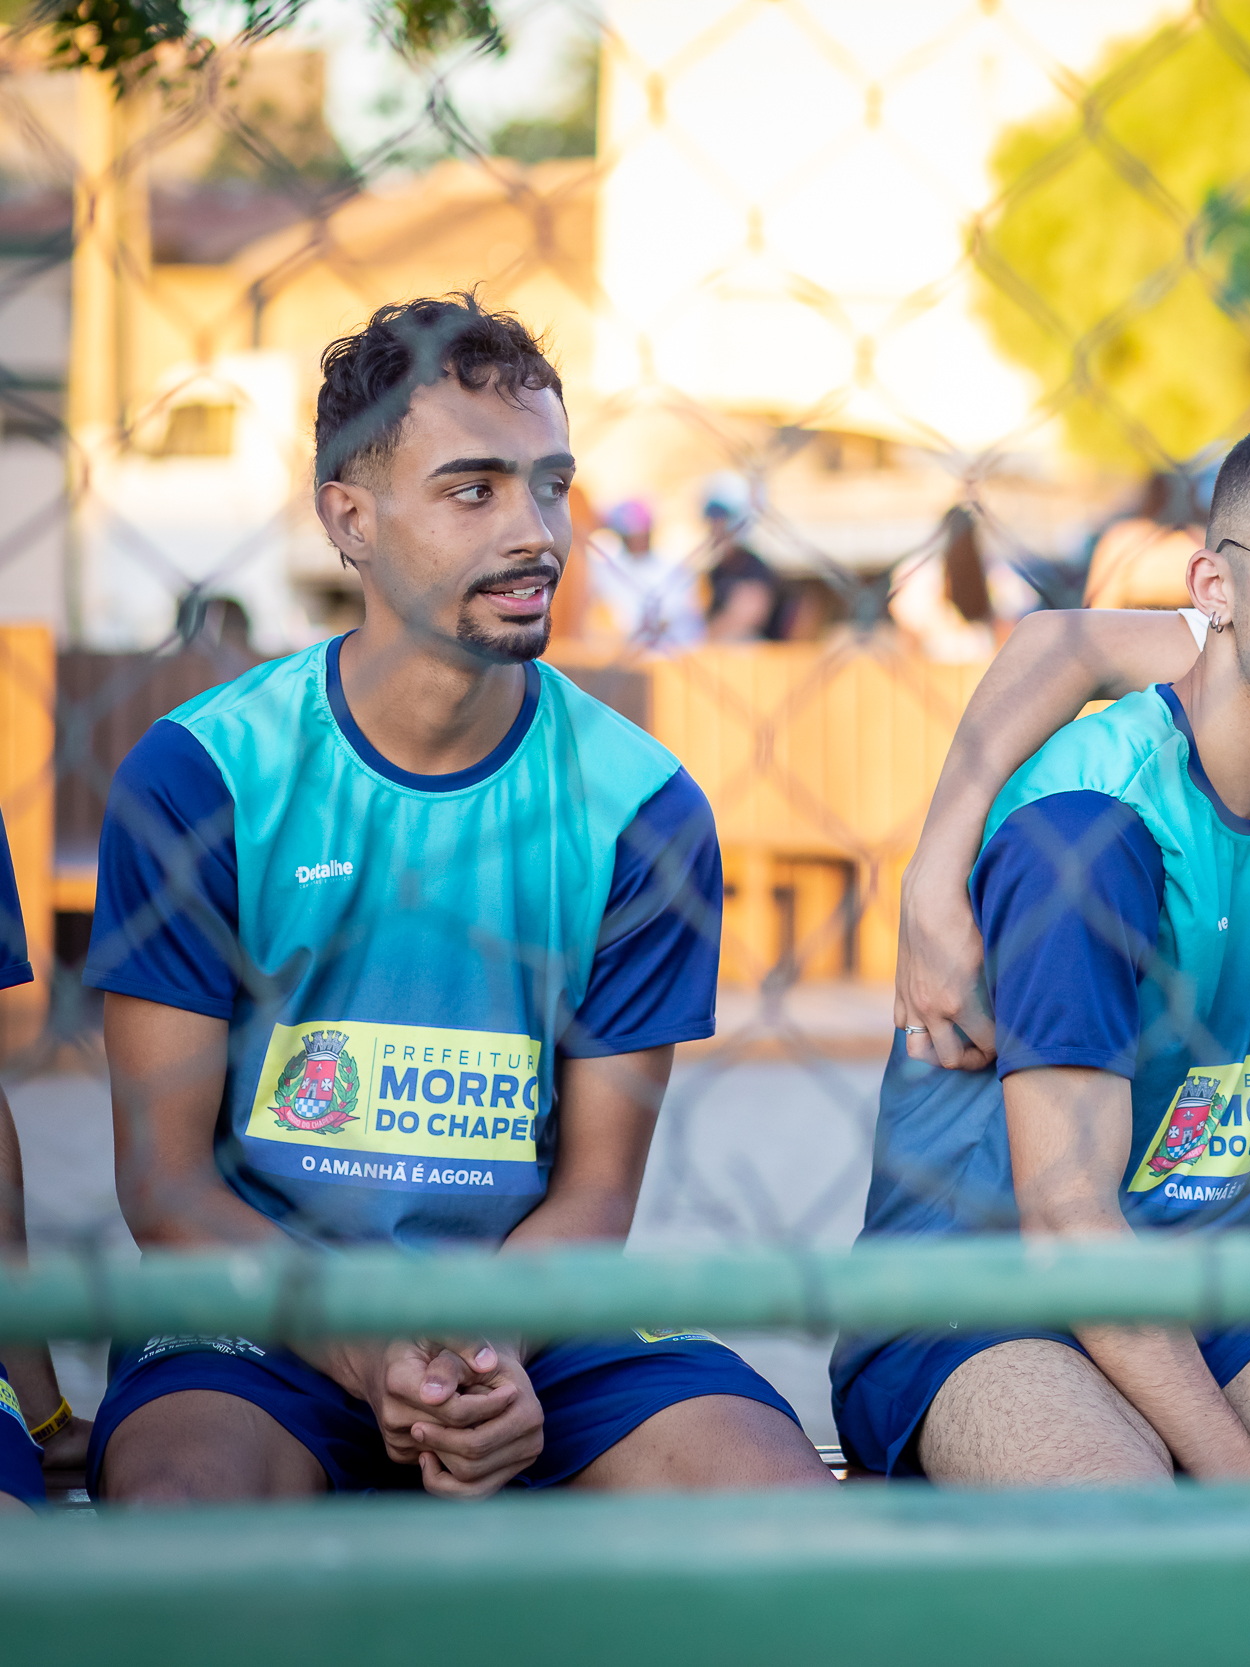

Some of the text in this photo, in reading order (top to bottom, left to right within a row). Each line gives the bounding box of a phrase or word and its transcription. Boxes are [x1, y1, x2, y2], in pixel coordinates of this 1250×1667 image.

[297, 859, 354, 884] Detalhe
[375, 1108, 420, 1134] DO
[1208, 1134, 1247, 1158] DO
[302, 1155, 494, 1186] O AMANHÃ É AGORA
[1165, 1182, 1178, 1198] O
